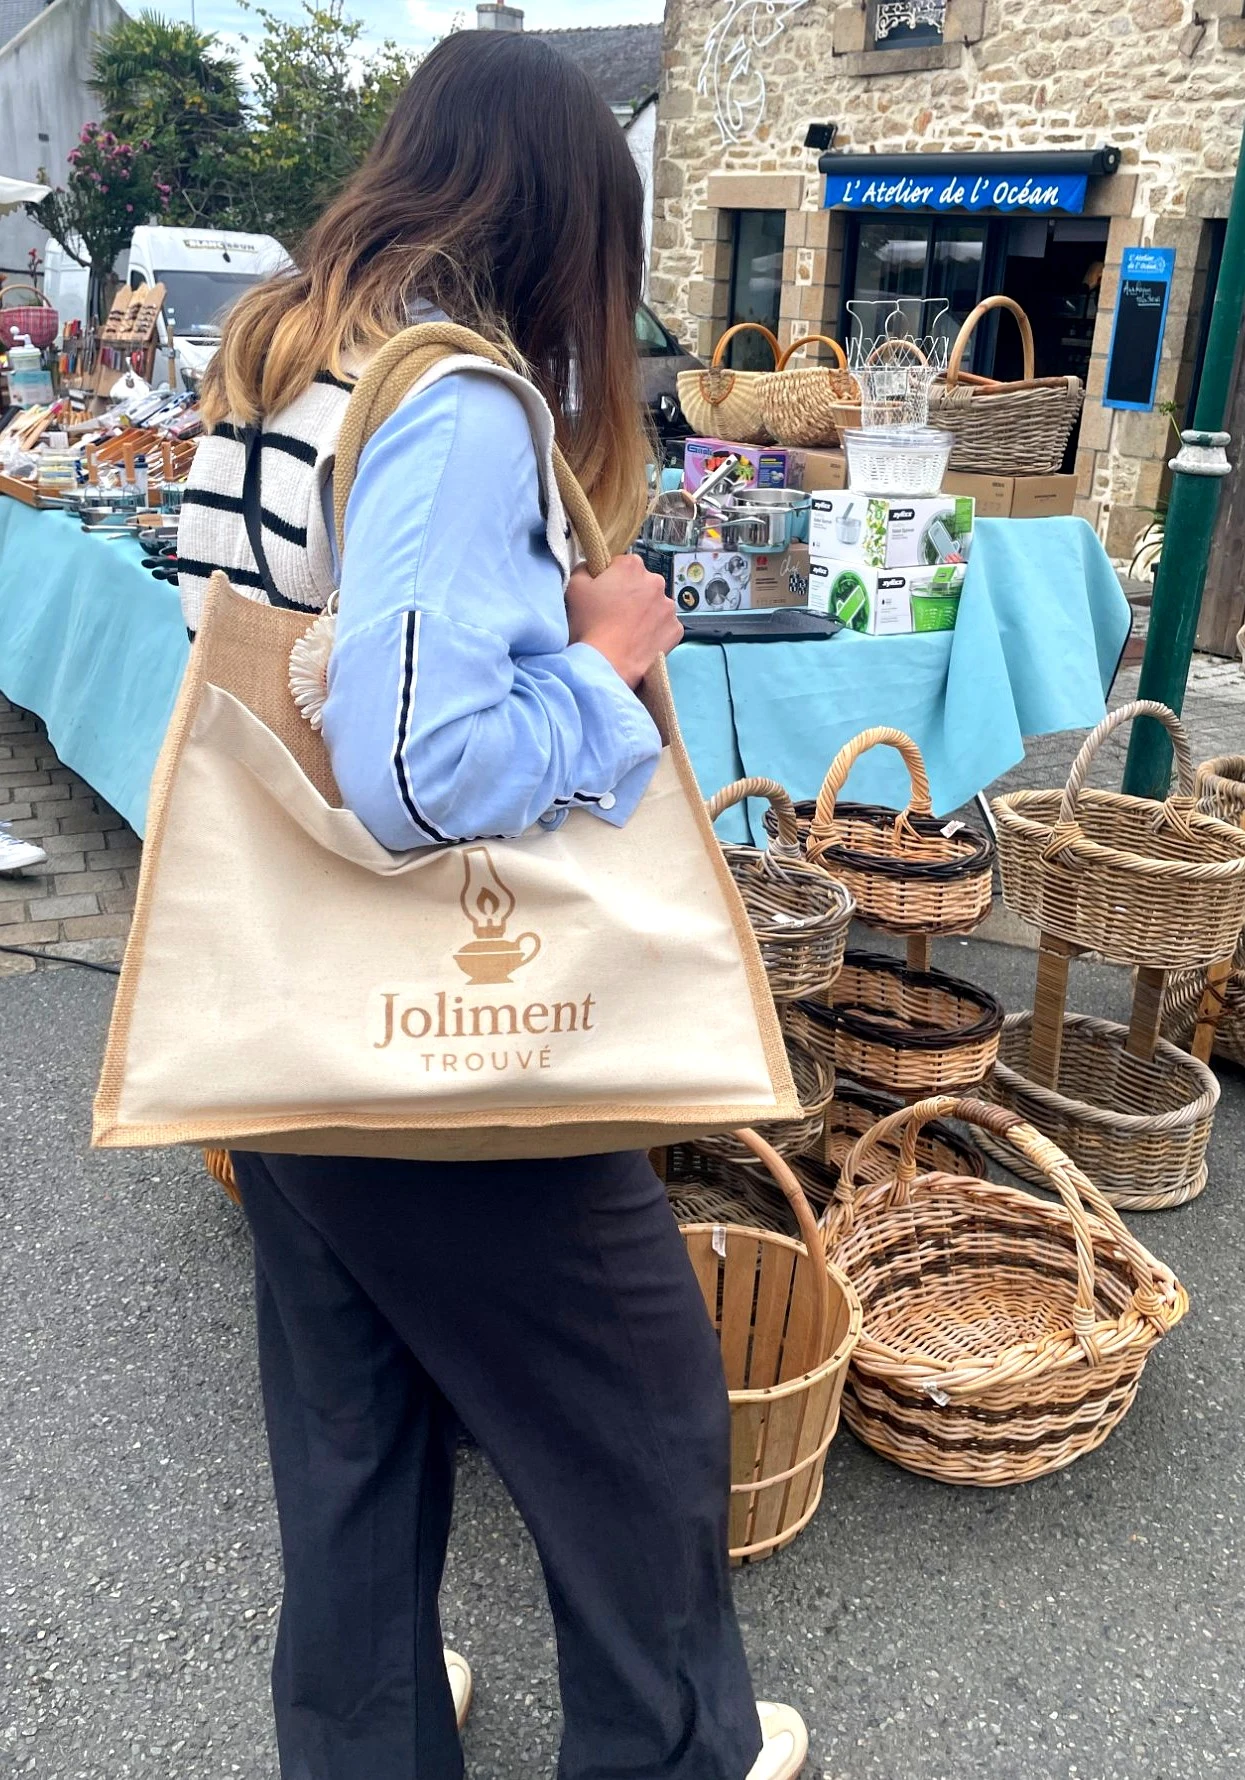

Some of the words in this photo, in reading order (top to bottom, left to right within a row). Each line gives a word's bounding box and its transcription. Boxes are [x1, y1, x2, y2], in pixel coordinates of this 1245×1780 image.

[939, 176, 965, 204] de
[373, 991, 596, 1049] Joliment
[420, 1044, 552, 1072] TROUVÉ
